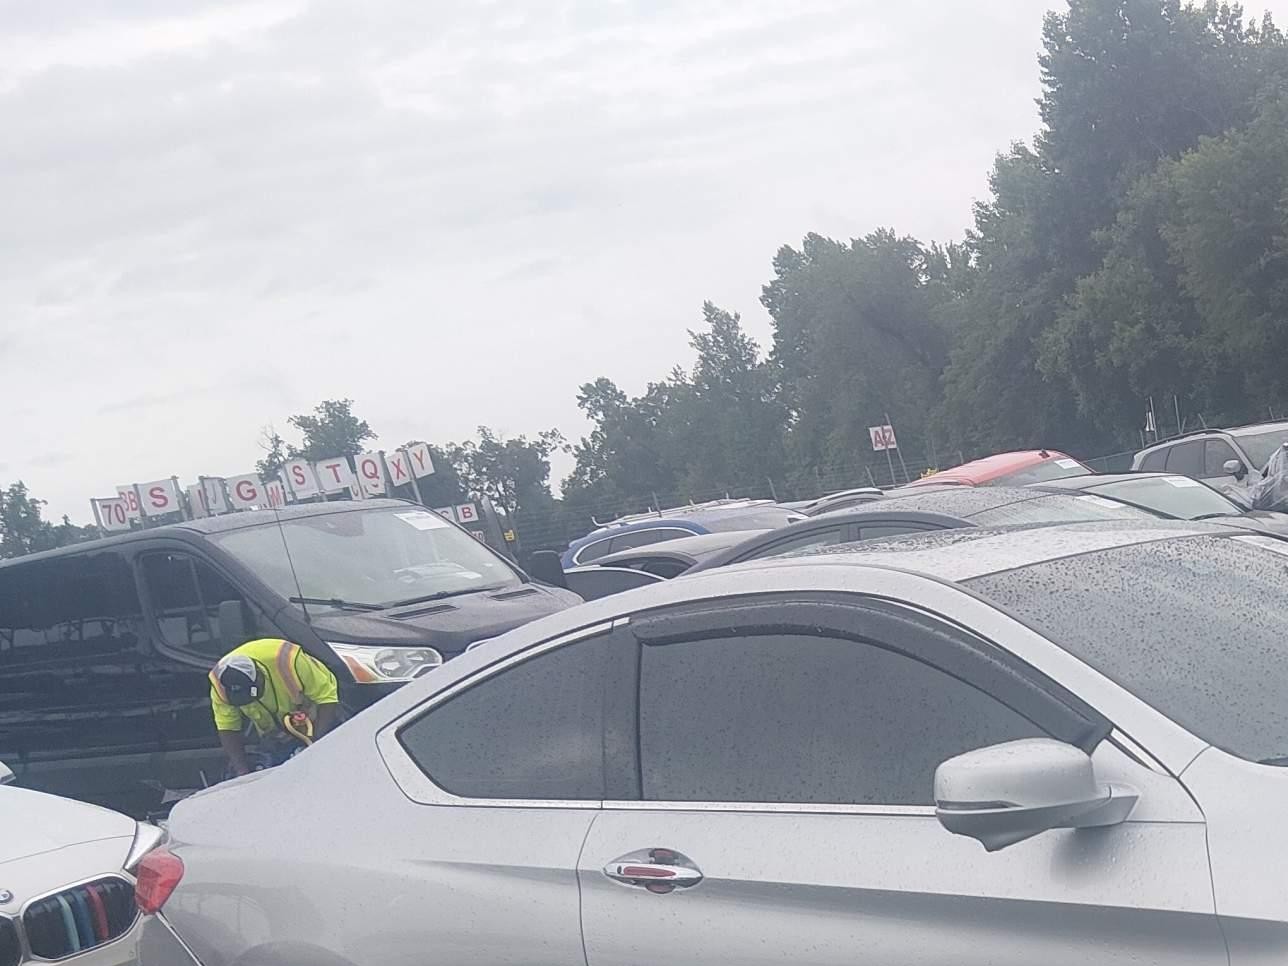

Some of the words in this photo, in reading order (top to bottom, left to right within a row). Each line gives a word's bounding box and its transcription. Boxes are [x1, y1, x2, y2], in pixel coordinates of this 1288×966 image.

[361, 459, 380, 480] Q
[391, 457, 407, 480] X
[413, 451, 425, 470] Y
[292, 464, 306, 486] S
[326, 463, 342, 484] T
[148, 486, 169, 508] S
[235, 480, 258, 502] G
[102, 503, 126, 525] 70
[461, 506, 473, 519] B
